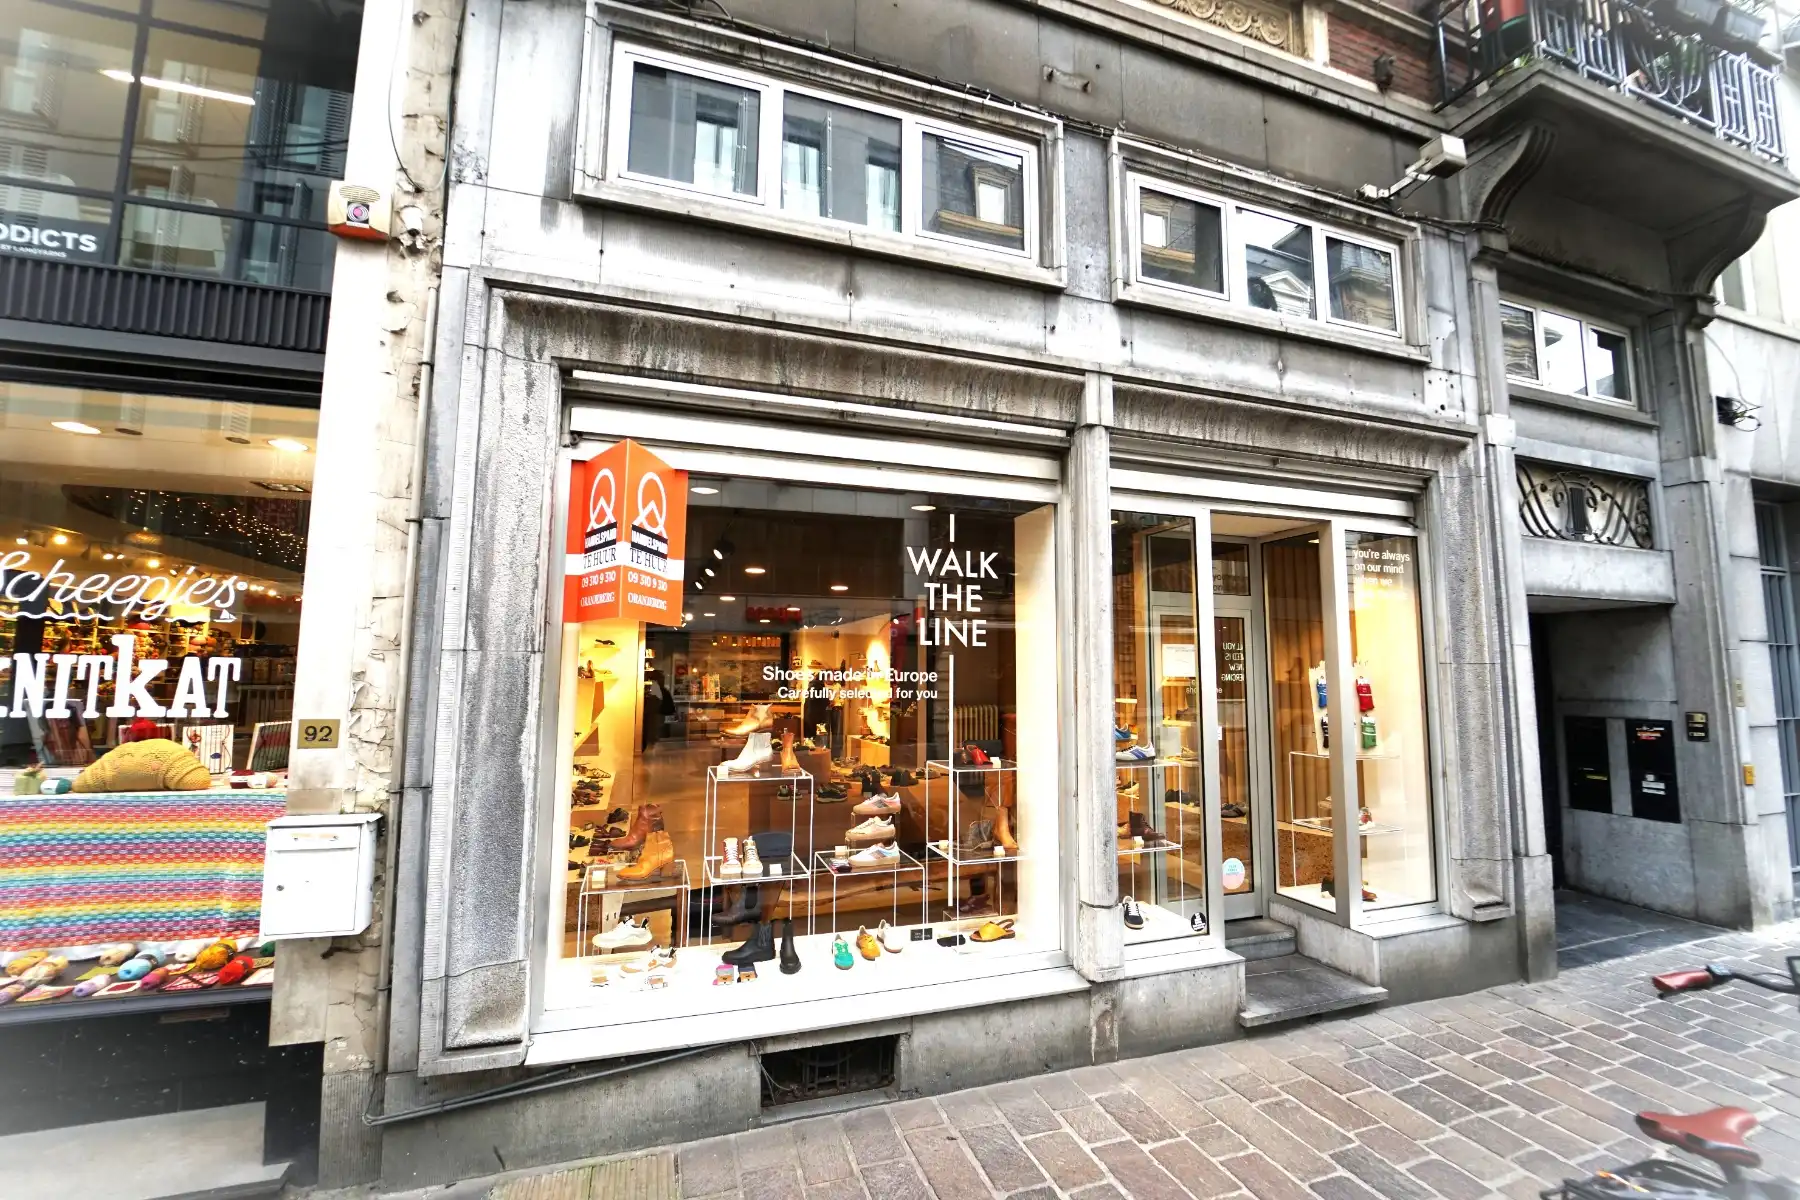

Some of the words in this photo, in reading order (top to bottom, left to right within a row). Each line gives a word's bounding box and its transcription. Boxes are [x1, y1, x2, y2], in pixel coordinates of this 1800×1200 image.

[583, 554, 592, 569] TE
[593, 547, 617, 566] HUUR
[630, 547, 642, 565] TE
[644, 552, 668, 573] HUUR
[906, 546, 999, 580] WALK
[1352, 549, 1380, 560] you're
[1381, 550, 1410, 563] always
[628, 570, 638, 583] 09
[652, 577, 657, 589] 9
[1354, 563, 1365, 571] on
[1367, 563, 1381, 572] our
[1383, 563, 1405, 574] mind
[924, 582, 983, 612] THE
[919, 617, 987, 647] LINE
[762, 665, 814, 681] Shoes
[818, 667, 863, 682] made
[886, 667, 938, 687] Europe
[777, 686, 837, 701] Carefully
[840, 687, 893, 699] selecd
[896, 687, 913, 699] for
[916, 689, 938, 701] you
[304, 725, 333, 742] 92
